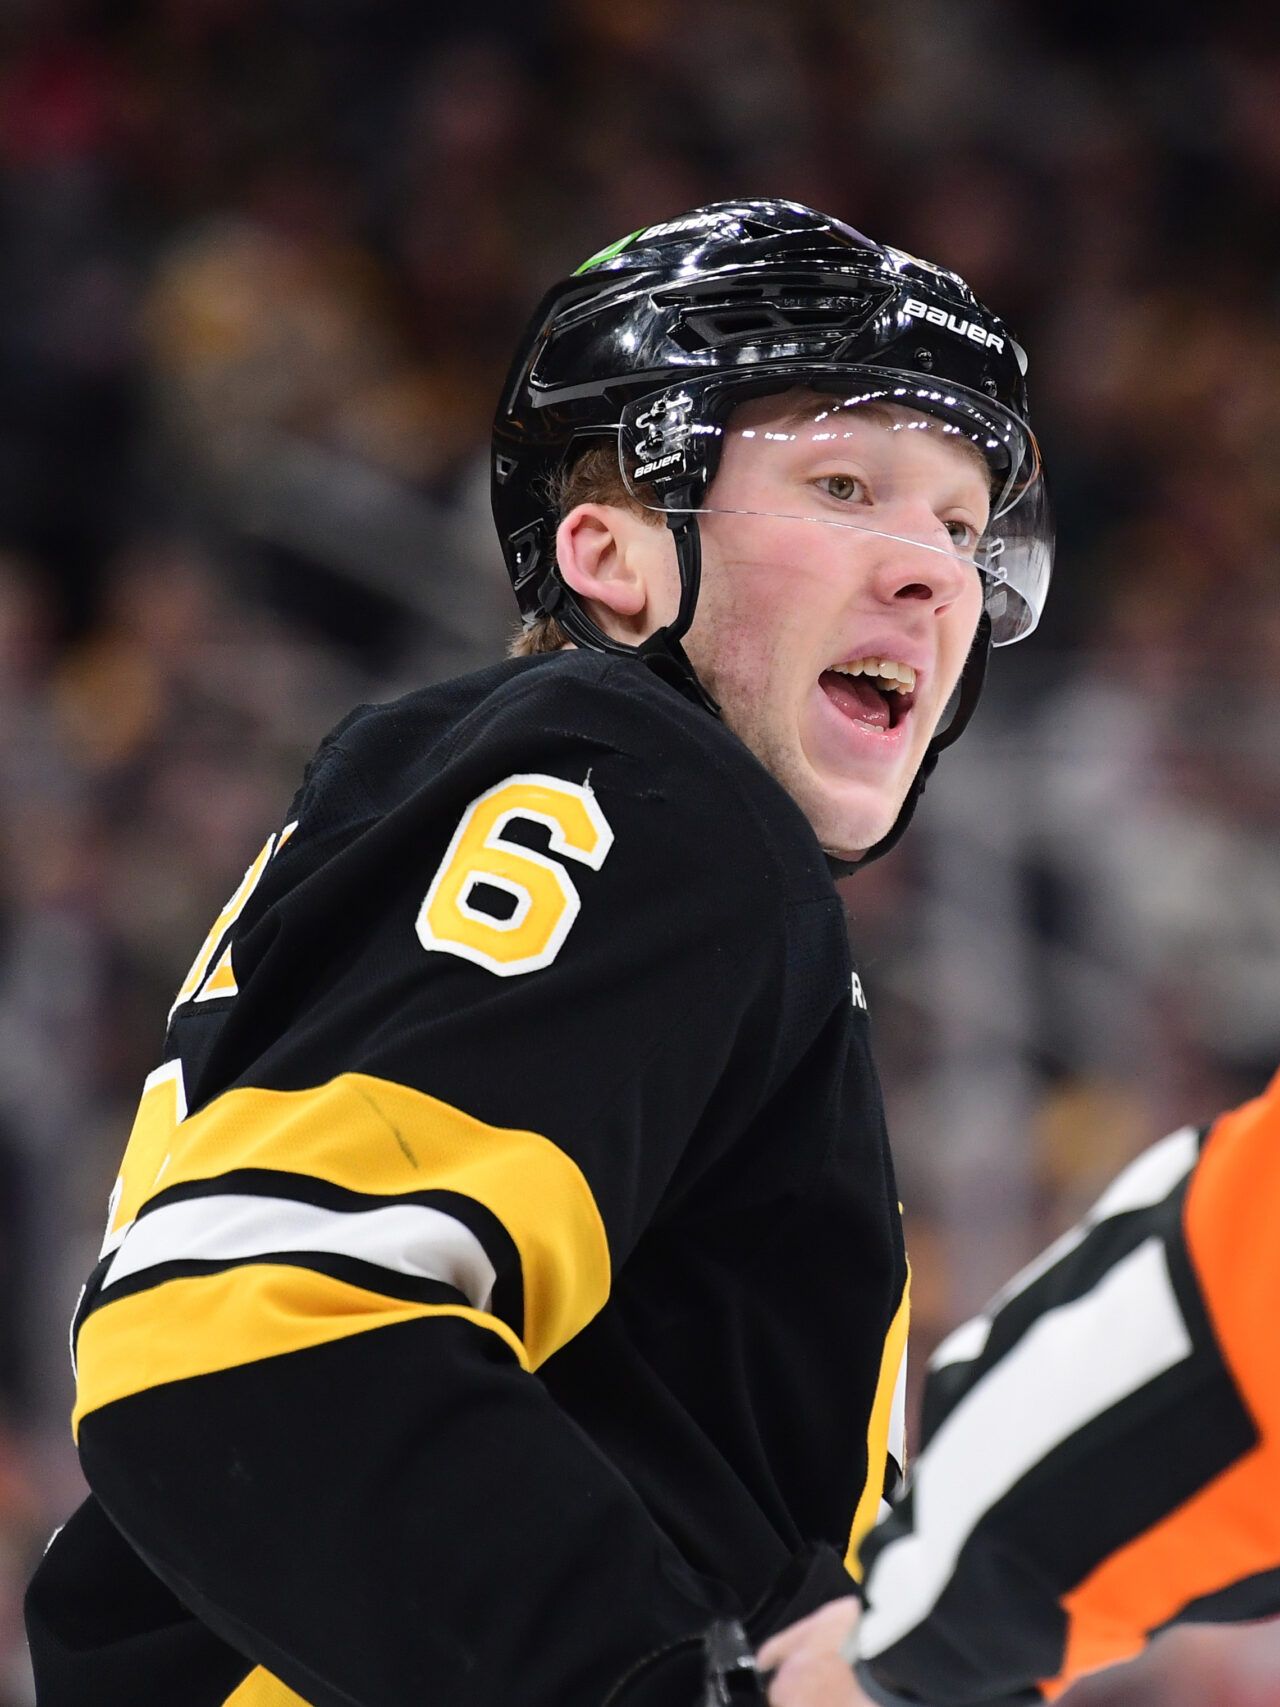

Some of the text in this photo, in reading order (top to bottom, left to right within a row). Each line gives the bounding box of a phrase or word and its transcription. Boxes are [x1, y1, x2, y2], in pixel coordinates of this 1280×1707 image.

[902, 298, 1004, 355] BAUER
[633, 452, 682, 479] BAUER
[415, 773, 614, 977] 6
